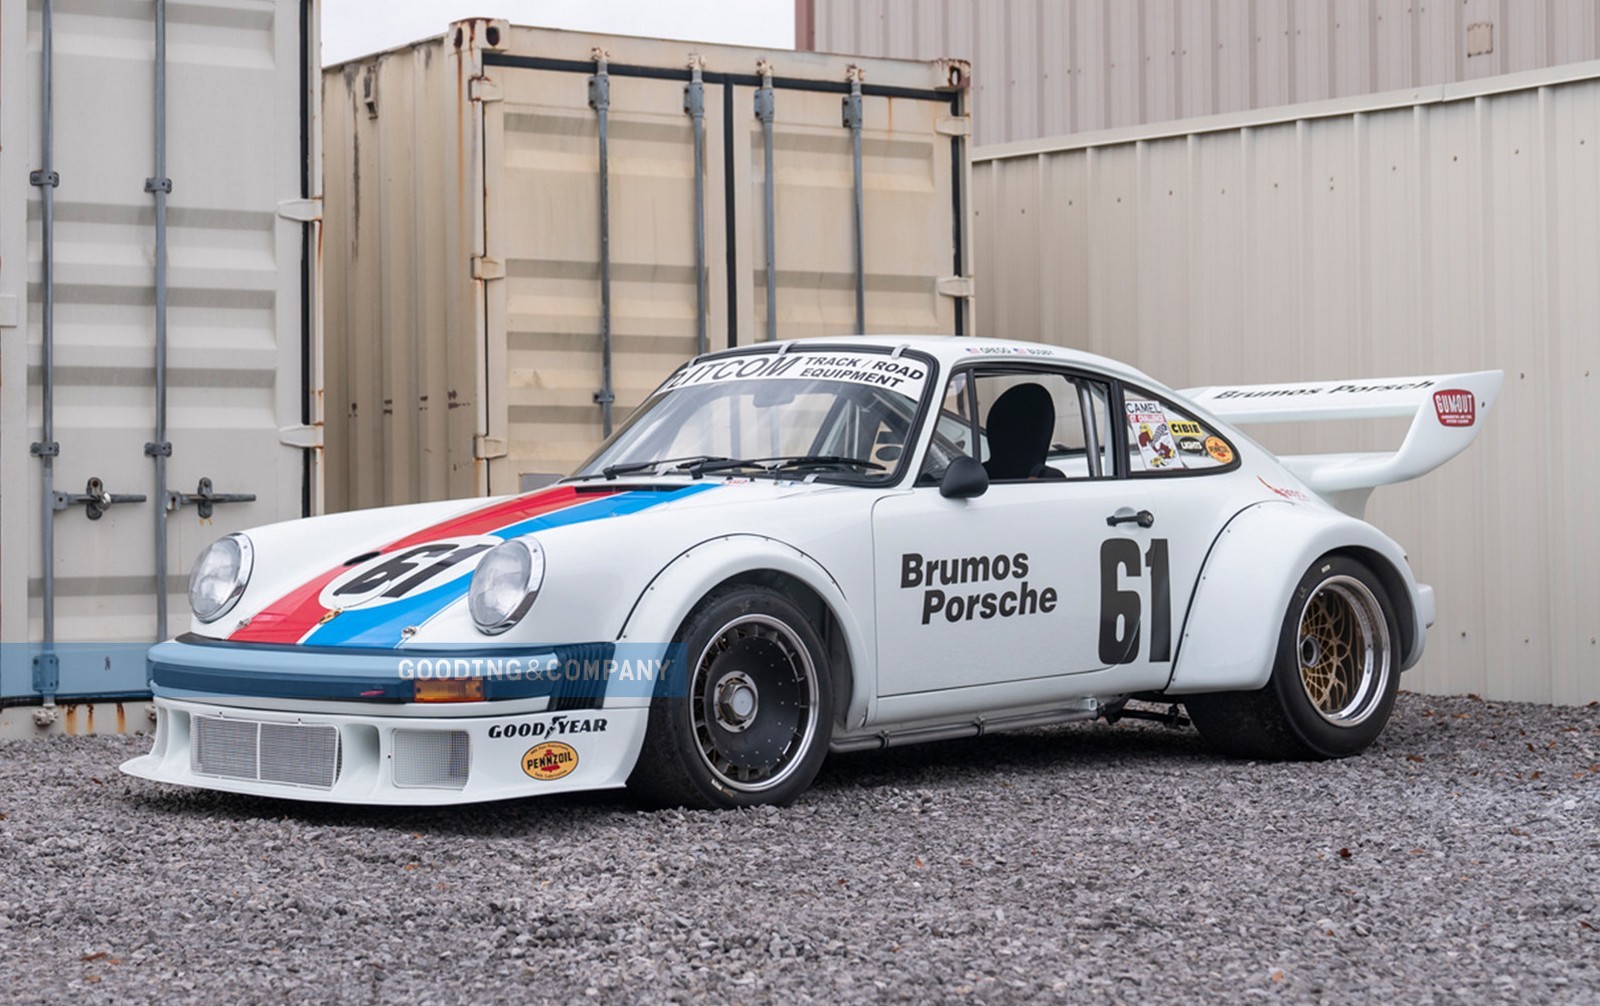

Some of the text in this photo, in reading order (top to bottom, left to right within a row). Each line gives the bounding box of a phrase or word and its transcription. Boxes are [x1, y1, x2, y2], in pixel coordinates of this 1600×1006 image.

[800, 367, 904, 388] EQUIPMENT
[805, 356, 864, 368] TRACK
[875, 360, 924, 380] ROAD
[1214, 380, 1435, 400] Brumos Porsch
[1126, 402, 1161, 414] CAMEL
[1171, 423, 1200, 434] CIBIE
[333, 544, 496, 598] 61
[900, 552, 1029, 589] Brumos
[921, 581, 1058, 625] Porsche
[1098, 537, 1172, 665] 61
[527, 752, 573, 770] PENNZOIL
